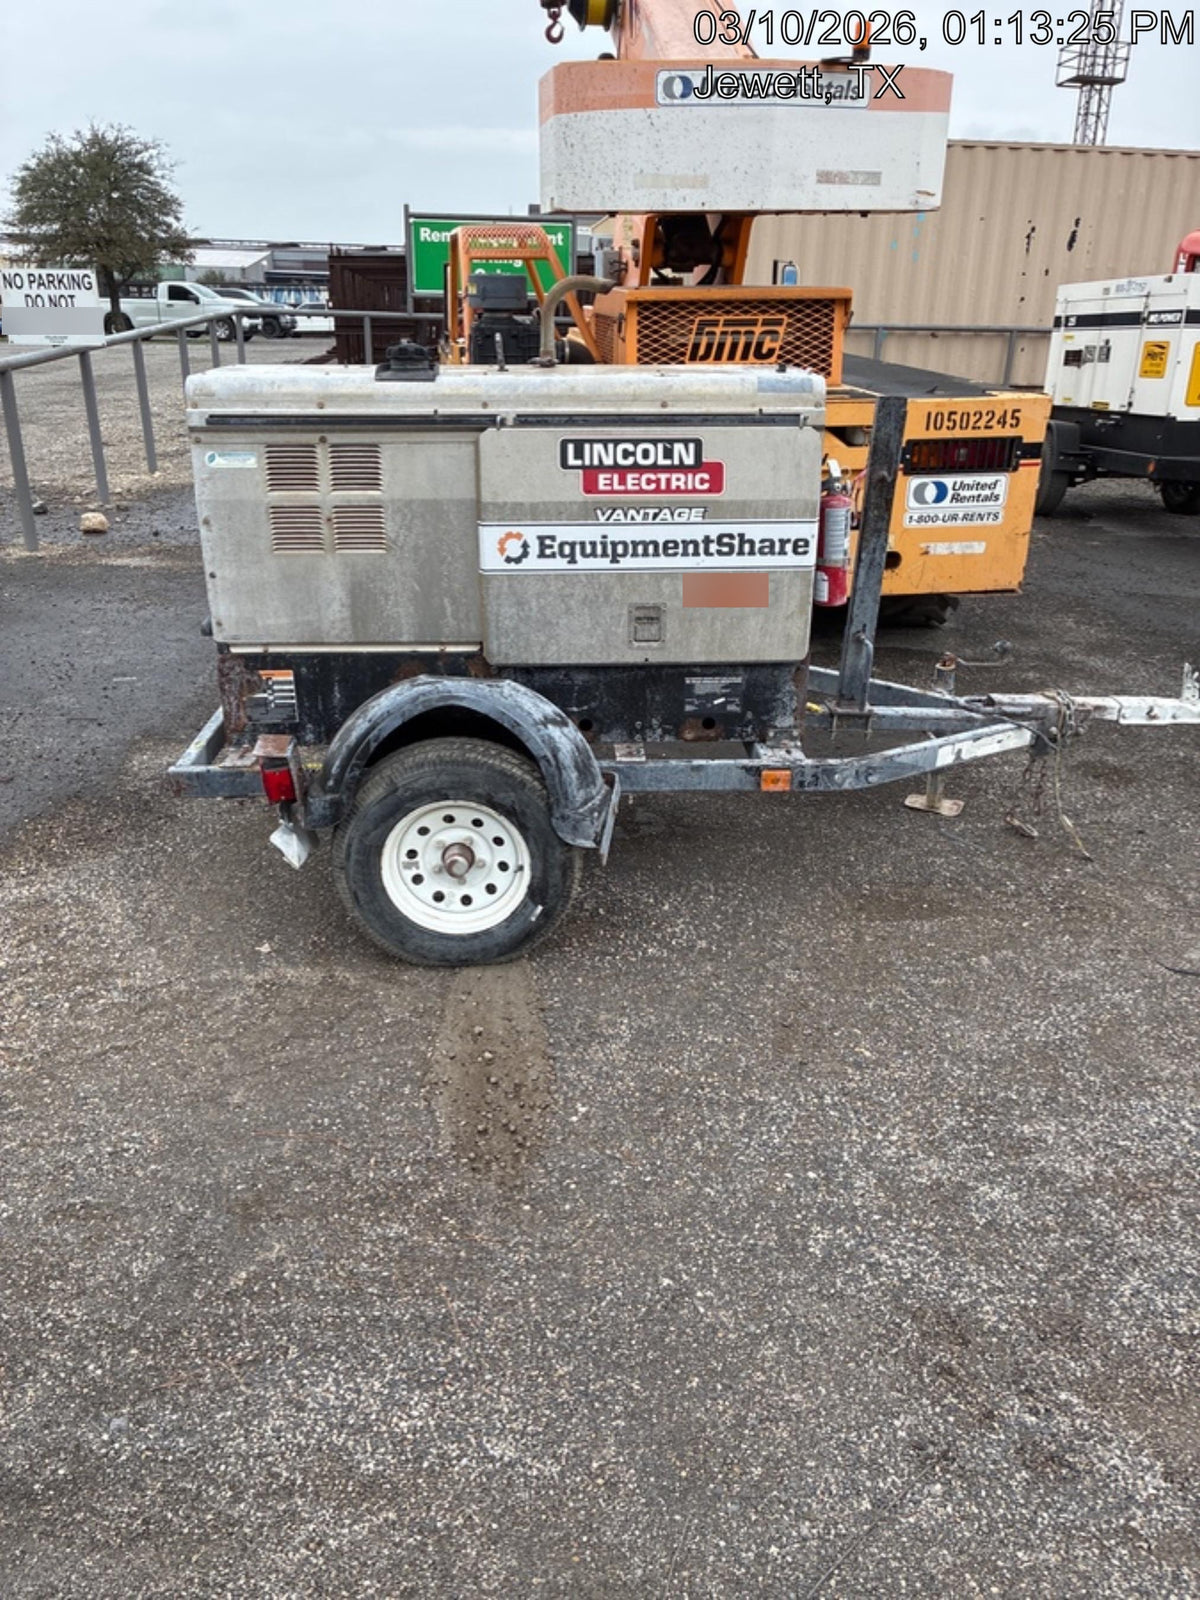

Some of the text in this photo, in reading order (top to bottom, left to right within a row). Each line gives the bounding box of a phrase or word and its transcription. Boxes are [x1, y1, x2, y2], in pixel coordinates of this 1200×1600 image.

[2, 272, 93, 291] NO PARKING
[24, 294, 76, 308] DO NOT
[925, 408, 1021, 431] 10502245
[566, 442, 696, 467] LINCOLN
[597, 472, 711, 491] ELECTRIC
[951, 478, 999, 492] United
[949, 491, 1000, 504] Rentals
[593, 507, 709, 521] VANTAGE
[908, 511, 1000, 524] 1-800-UR-RENTS
[535, 532, 810, 564] EquipmentShare
